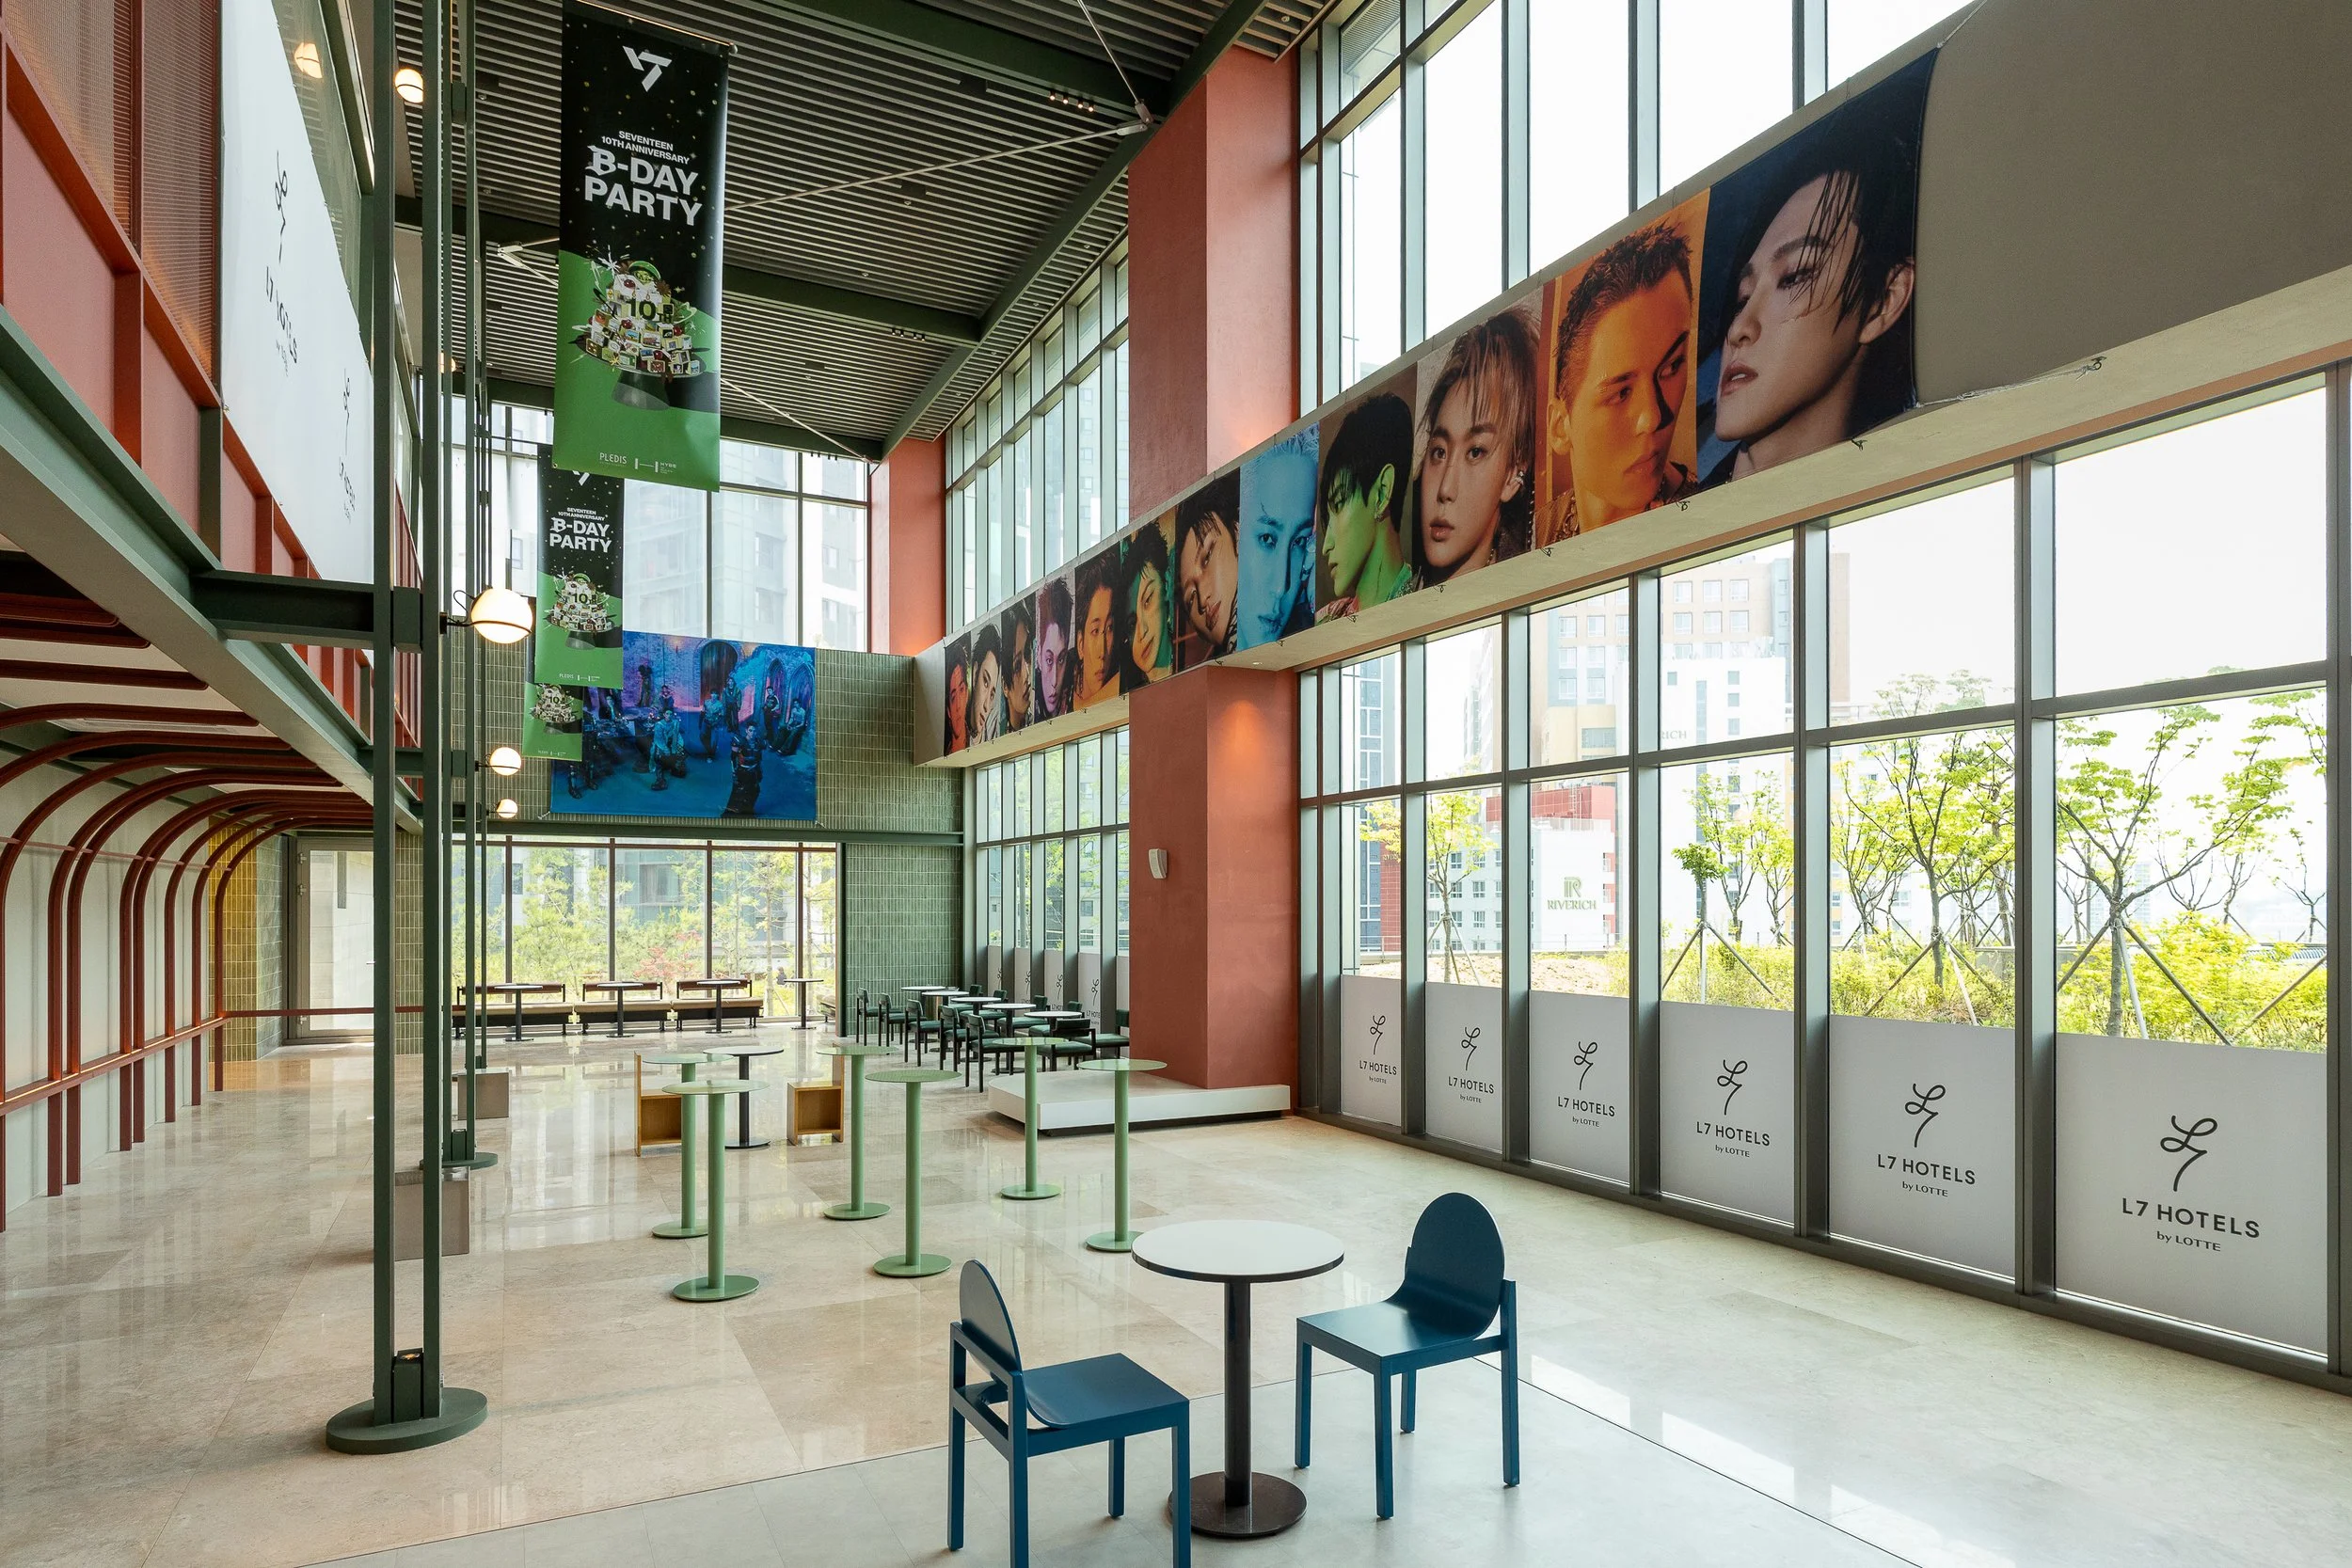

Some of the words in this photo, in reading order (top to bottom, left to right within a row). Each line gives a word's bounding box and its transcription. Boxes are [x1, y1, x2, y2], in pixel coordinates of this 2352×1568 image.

[601, 135, 625, 149] 10TH
[626, 141, 690, 165] ANNIVERSARY
[619, 131, 674, 150] SEVENTEEN
[585, 145, 698, 196] B-DAY
[585, 175, 703, 226] PARTY
[599, 452, 628, 465] PLEDIS
[566, 507, 596, 515] SEVENTEEN
[571, 513, 605, 521] ANNIVERSARY
[549, 517, 610, 537] B-DAY
[549, 533, 612, 553] PARTY
[1548, 899, 1597, 910] RIVERICH
[1359, 1060, 1367, 1069] L7
[1369, 1062, 1397, 1075] HOTELS
[1449, 1076, 1457, 1086] L7
[1460, 1078, 1494, 1094] HOTELS
[1558, 1097, 1569, 1107] L7
[1573, 1100, 1615, 1117] HOTELS
[1581, 1118, 1599, 1127] LOTTE
[1696, 1121, 1711, 1134] L7
[1716, 1125, 1770, 1146] HOTELS
[1715, 1145, 1724, 1153] by
[1725, 1148, 1750, 1157] LOTTE
[1878, 1154, 1897, 1169] L7
[1902, 1159, 1976, 1184] HOTELS
[1902, 1181, 1914, 1192] by
[1915, 1184, 1948, 1196] LOTTE
[2122, 1198, 2149, 1216] L7
[2157, 1204, 2260, 1238] HOTELS
[2157, 1231, 2172, 1243] by
[2175, 1235, 2221, 1251] LOTTE
